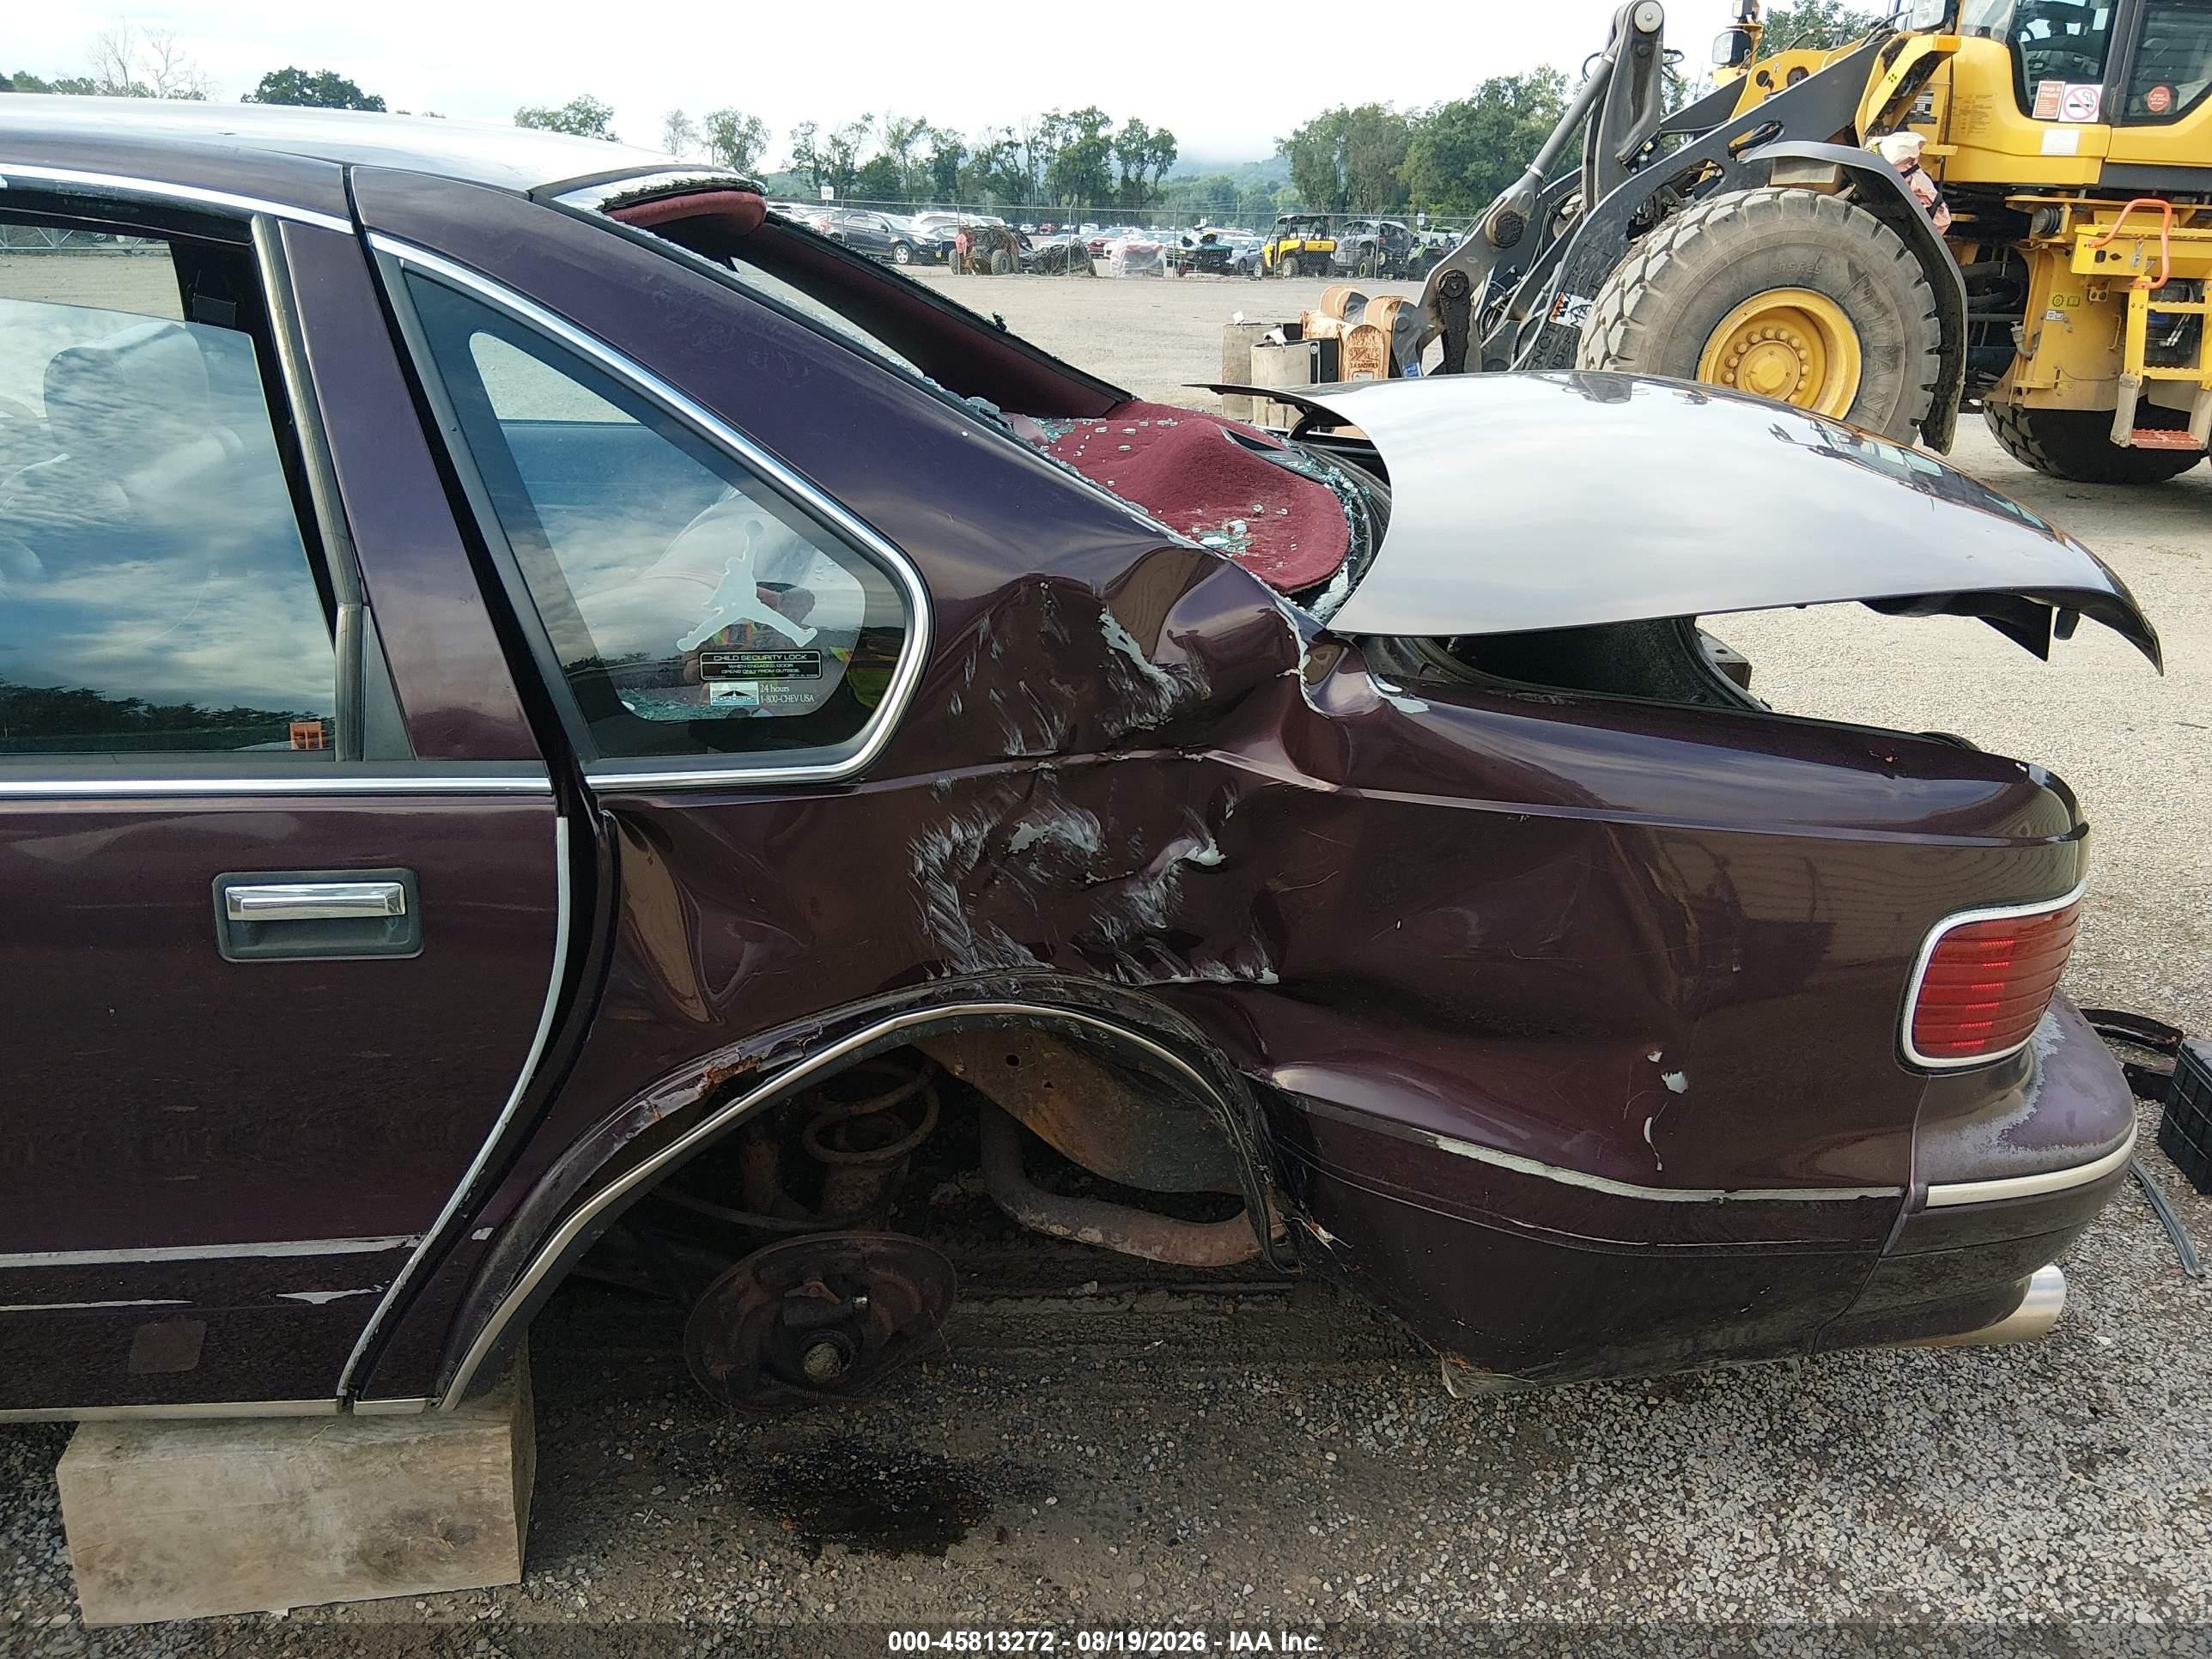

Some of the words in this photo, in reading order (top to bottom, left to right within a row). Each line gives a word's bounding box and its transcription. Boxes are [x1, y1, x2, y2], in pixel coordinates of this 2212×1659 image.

[1855, 286, 1894, 420] TITAN
[760, 684, 769, 693] 24
[770, 684, 790, 693] hours
